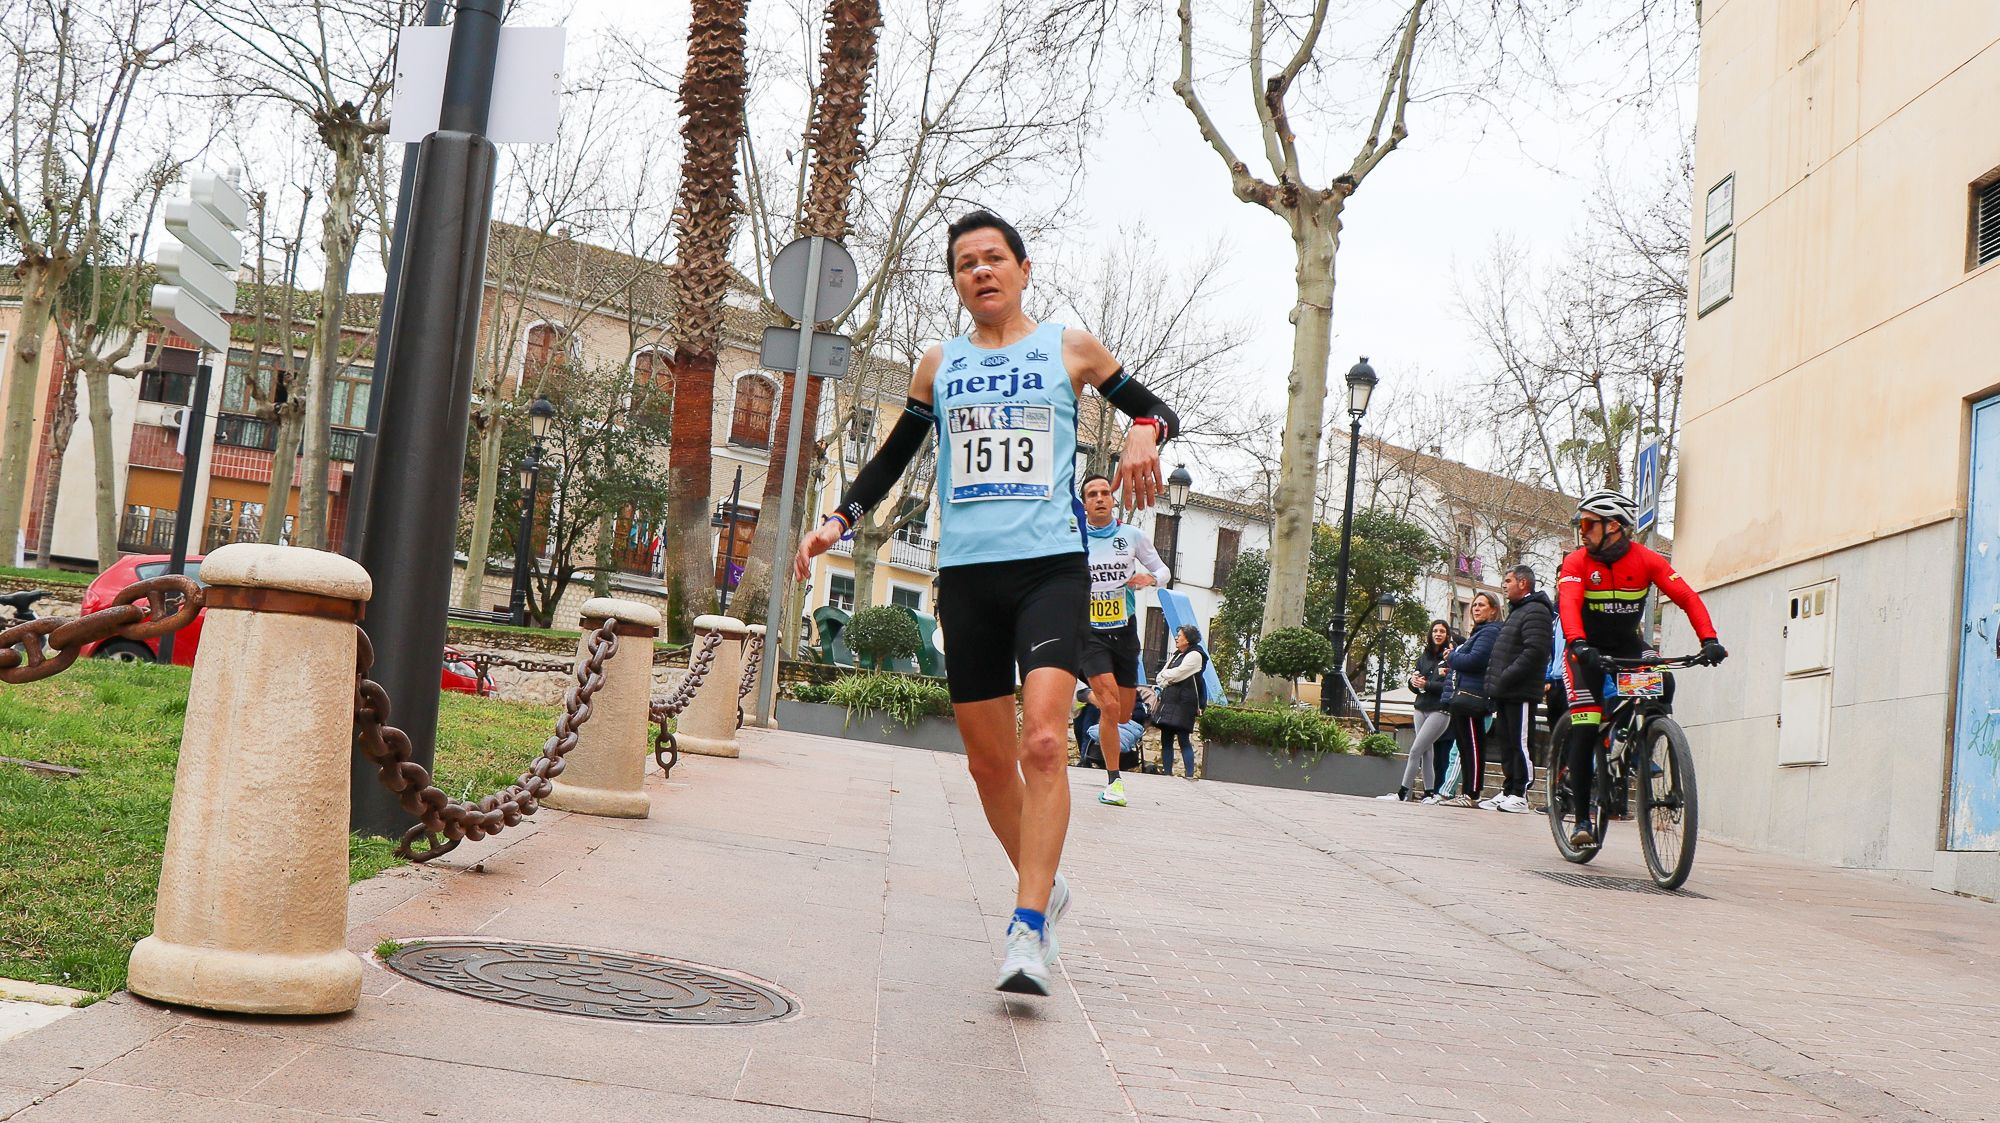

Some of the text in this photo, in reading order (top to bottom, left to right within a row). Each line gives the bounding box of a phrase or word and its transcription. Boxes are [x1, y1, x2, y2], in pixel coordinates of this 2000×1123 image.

[945, 367, 1045, 399] nerja
[960, 407, 992, 431] 21K
[963, 436, 1034, 474] 1513
[1091, 571, 1127, 582] AENA
[1090, 600, 1120, 617] 1028
